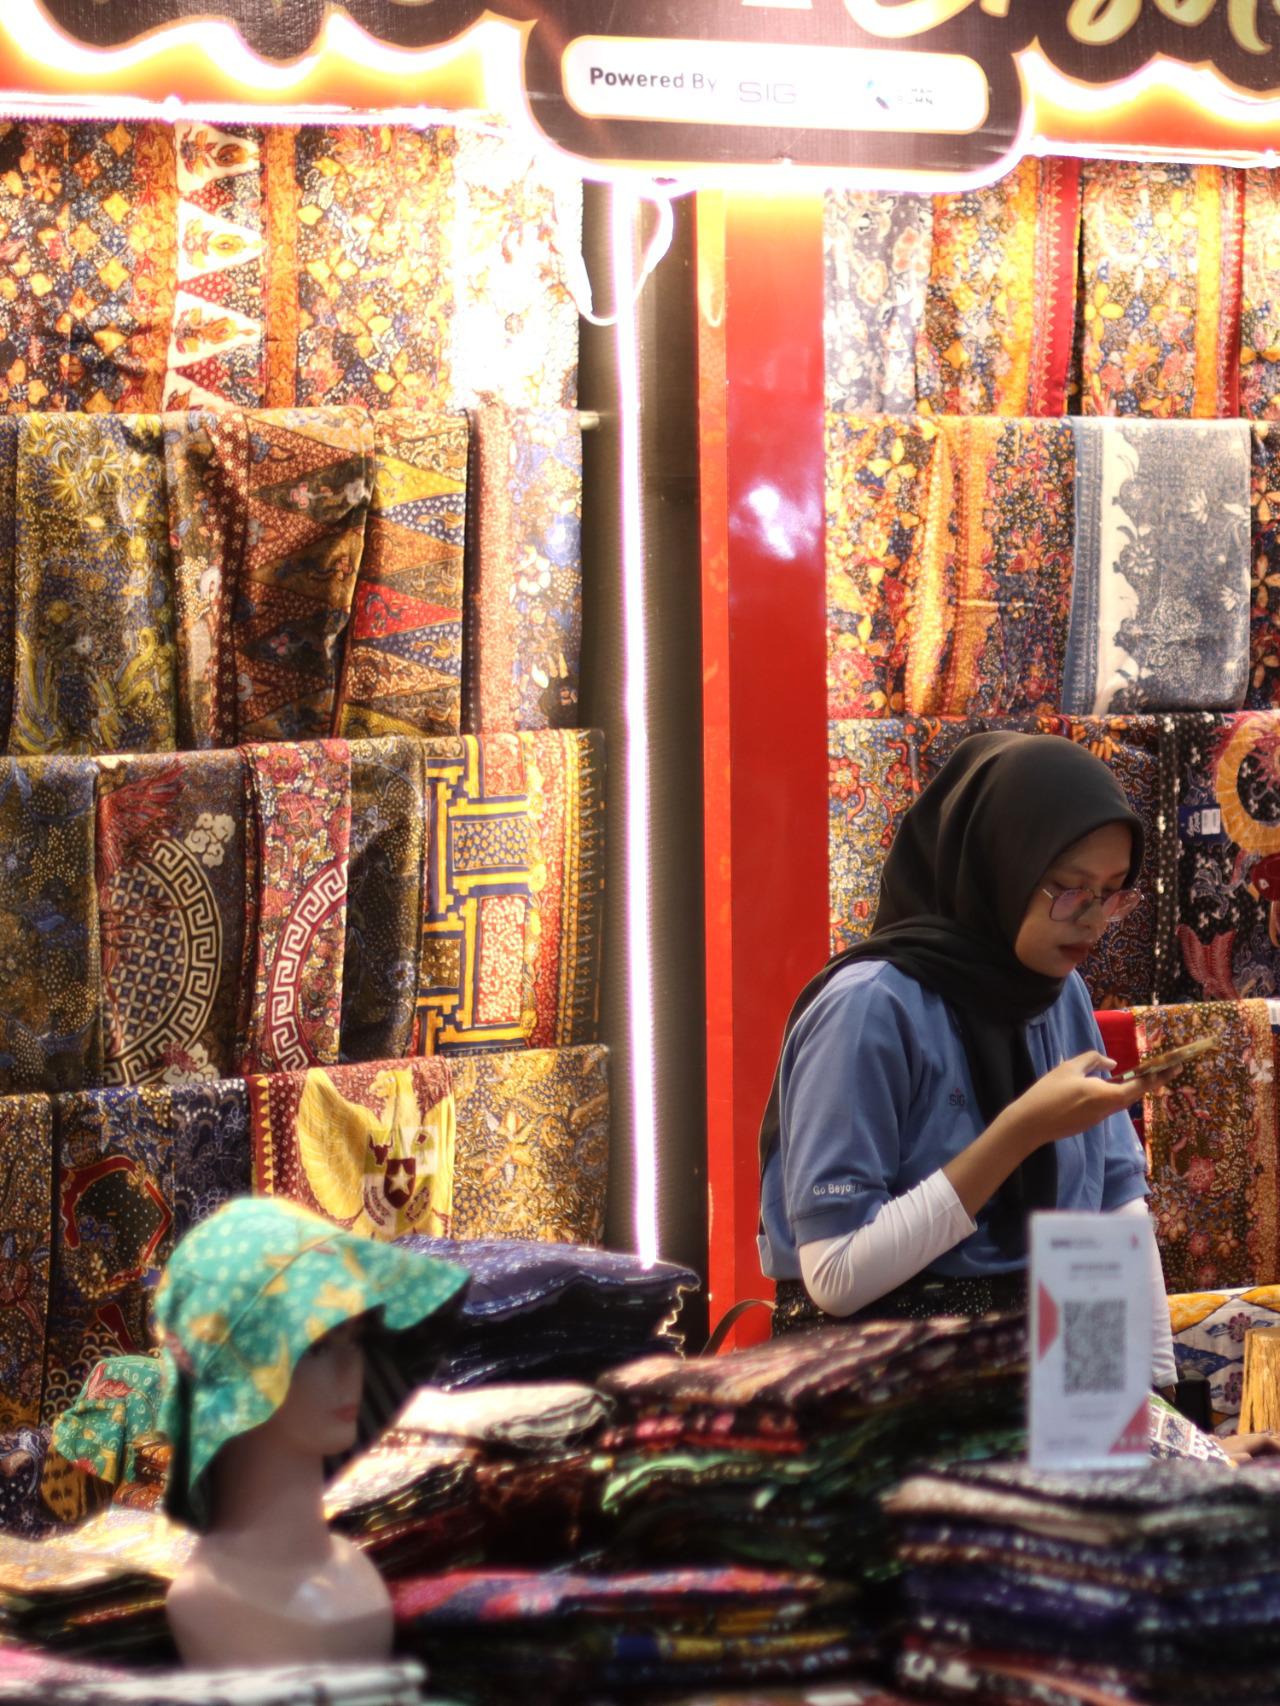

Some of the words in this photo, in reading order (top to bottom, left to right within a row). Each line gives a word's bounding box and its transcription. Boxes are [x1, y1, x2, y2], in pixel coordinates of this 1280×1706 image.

[589, 66, 685, 89] Powered
[691, 73, 718, 93] By
[738, 81, 797, 105] SIG
[812, 1184, 826, 1196] Go
